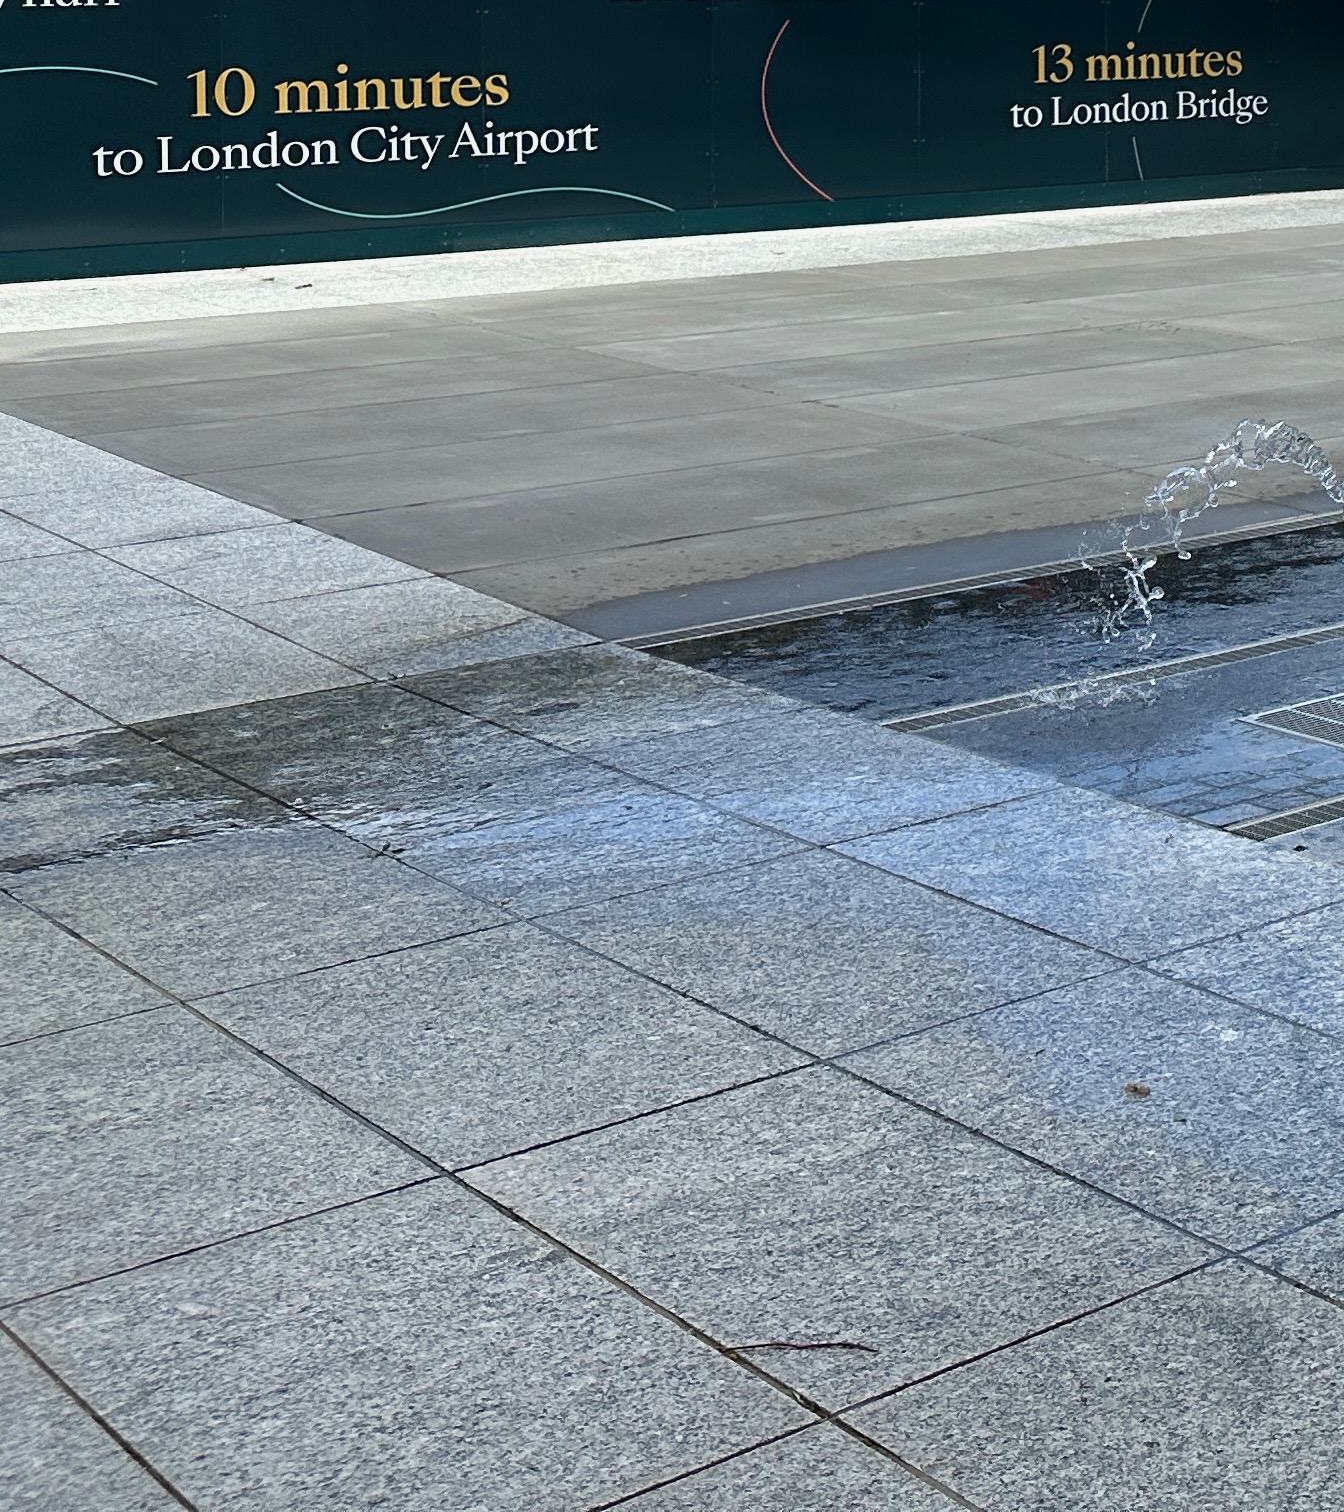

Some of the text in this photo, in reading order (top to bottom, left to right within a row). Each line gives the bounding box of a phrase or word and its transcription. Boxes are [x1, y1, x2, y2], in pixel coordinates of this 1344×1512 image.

[1031, 41, 1243, 84] 13 minutes
[186, 63, 510, 118] 10 minutes
[1009, 88, 1269, 129] to London Bridge
[92, 121, 600, 177] to London City Airport
